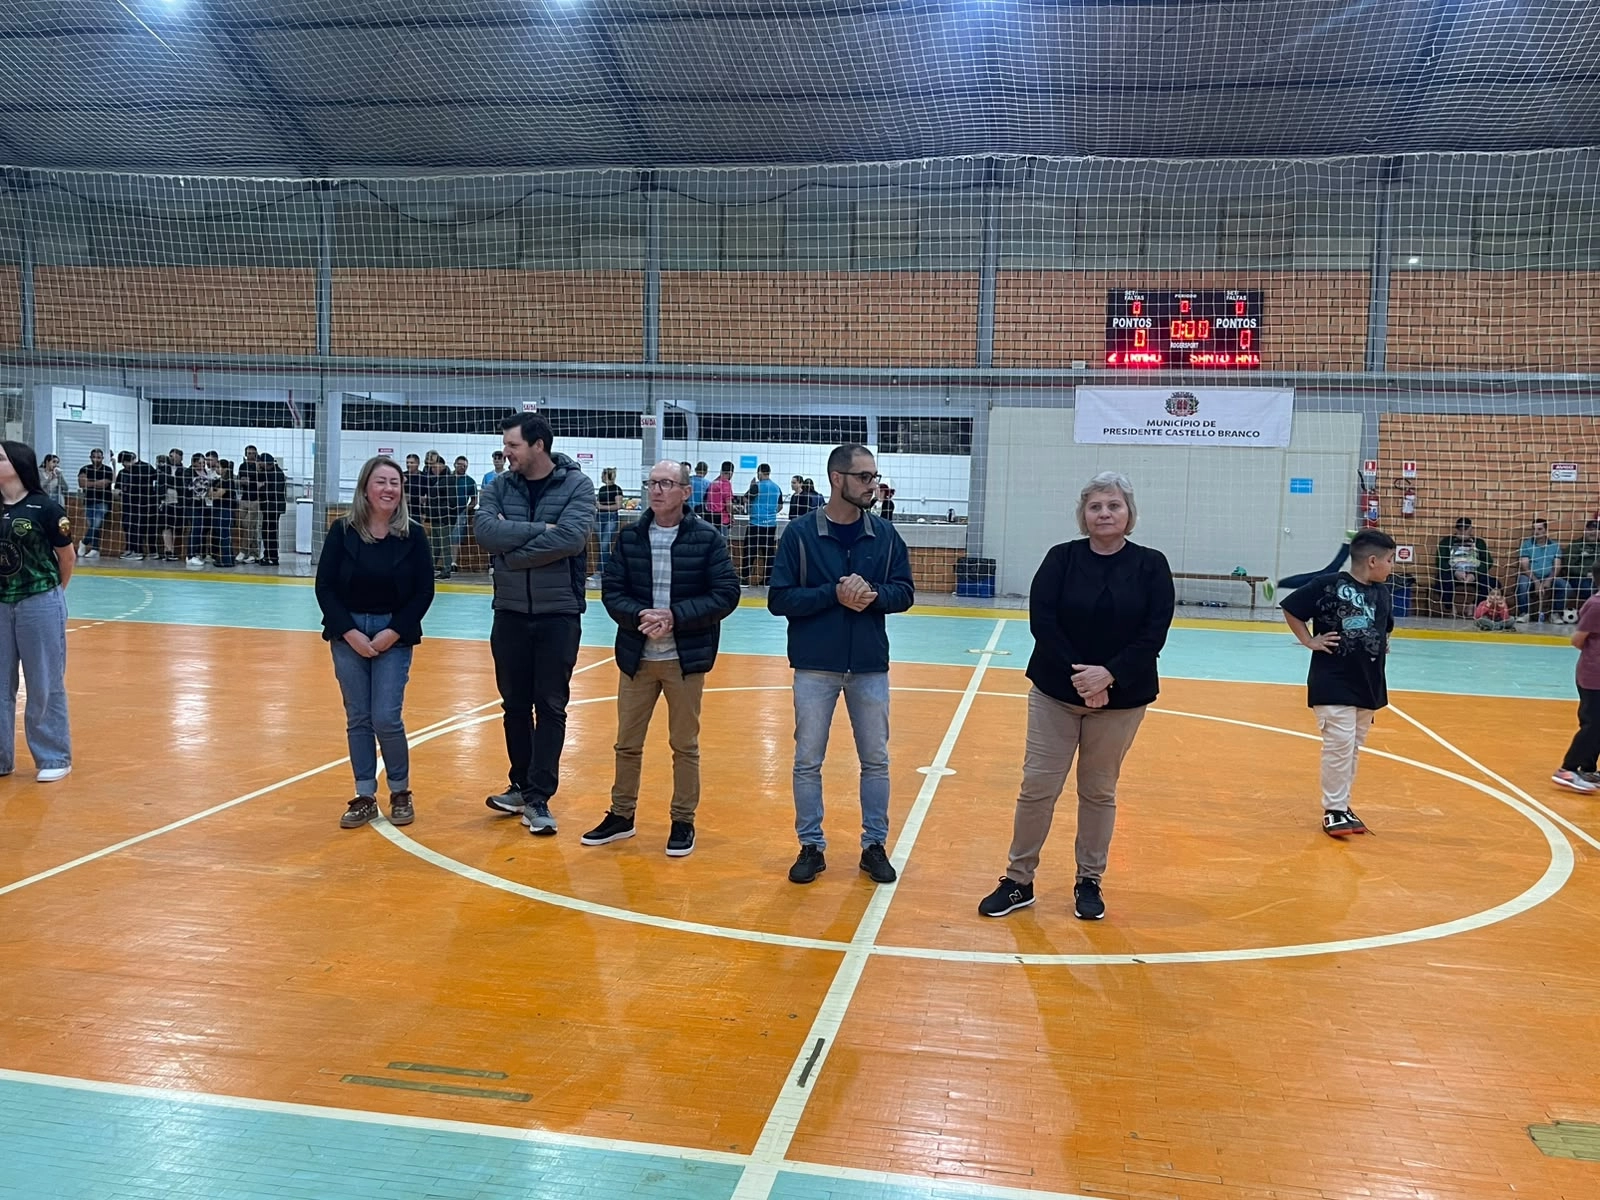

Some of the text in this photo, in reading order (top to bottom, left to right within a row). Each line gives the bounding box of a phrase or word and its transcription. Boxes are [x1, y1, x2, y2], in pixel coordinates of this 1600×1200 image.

[1112, 318, 1152, 328] PONTOS
[1216, 318, 1256, 328] PONTOS
[1146, 418, 1200, 428] MUNICÍPIO
[1103, 428, 1260, 438] PRESIDENTE CASTELLO BRANCO
